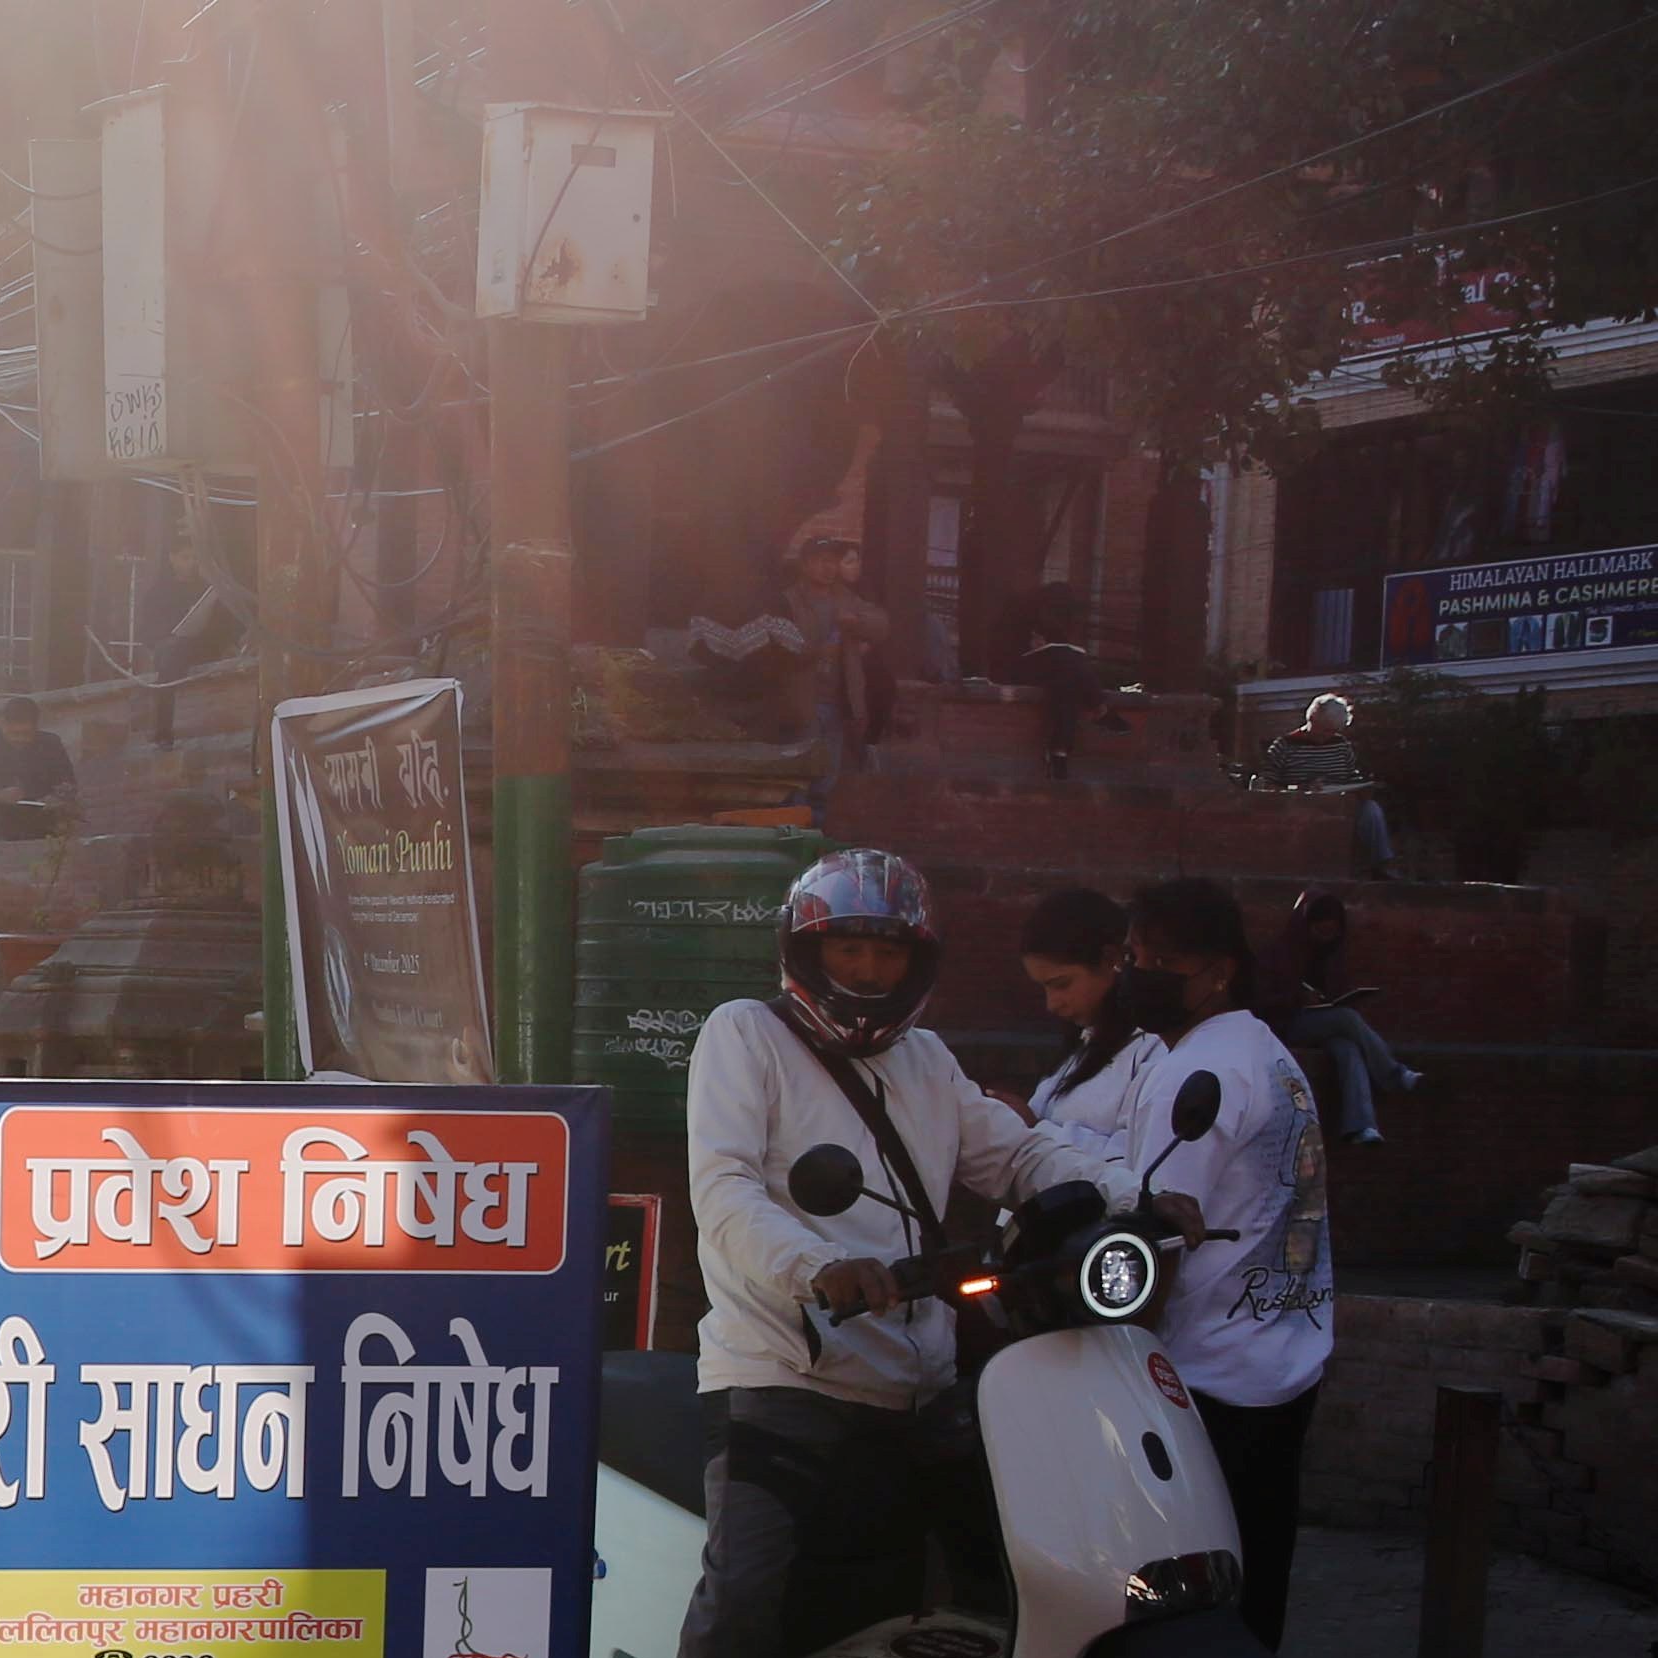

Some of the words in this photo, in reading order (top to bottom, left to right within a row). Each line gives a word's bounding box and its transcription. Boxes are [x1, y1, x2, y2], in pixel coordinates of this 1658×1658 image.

[1450, 564, 1549, 592] HIMALAYAN
[1552, 552, 1654, 579] HALLMARK
[1439, 591, 1532, 617] PASHMINA
[1537, 590, 1558, 607] &
[1555, 576, 1658, 604] CASHMERE
[336, 829, 391, 874] Yomari
[395, 820, 454, 873] Punhi
[26, 1127, 250, 1260] प्रवेश
[279, 1126, 538, 1248] निषेध
[79, 1364, 316, 1513] साधन
[340, 1312, 560, 1498] निषेध
[78, 1582, 204, 1609] महानगर
[212, 1577, 285, 1609] प्रहरी
[133, 1612, 365, 1643] महानगरपालिका
